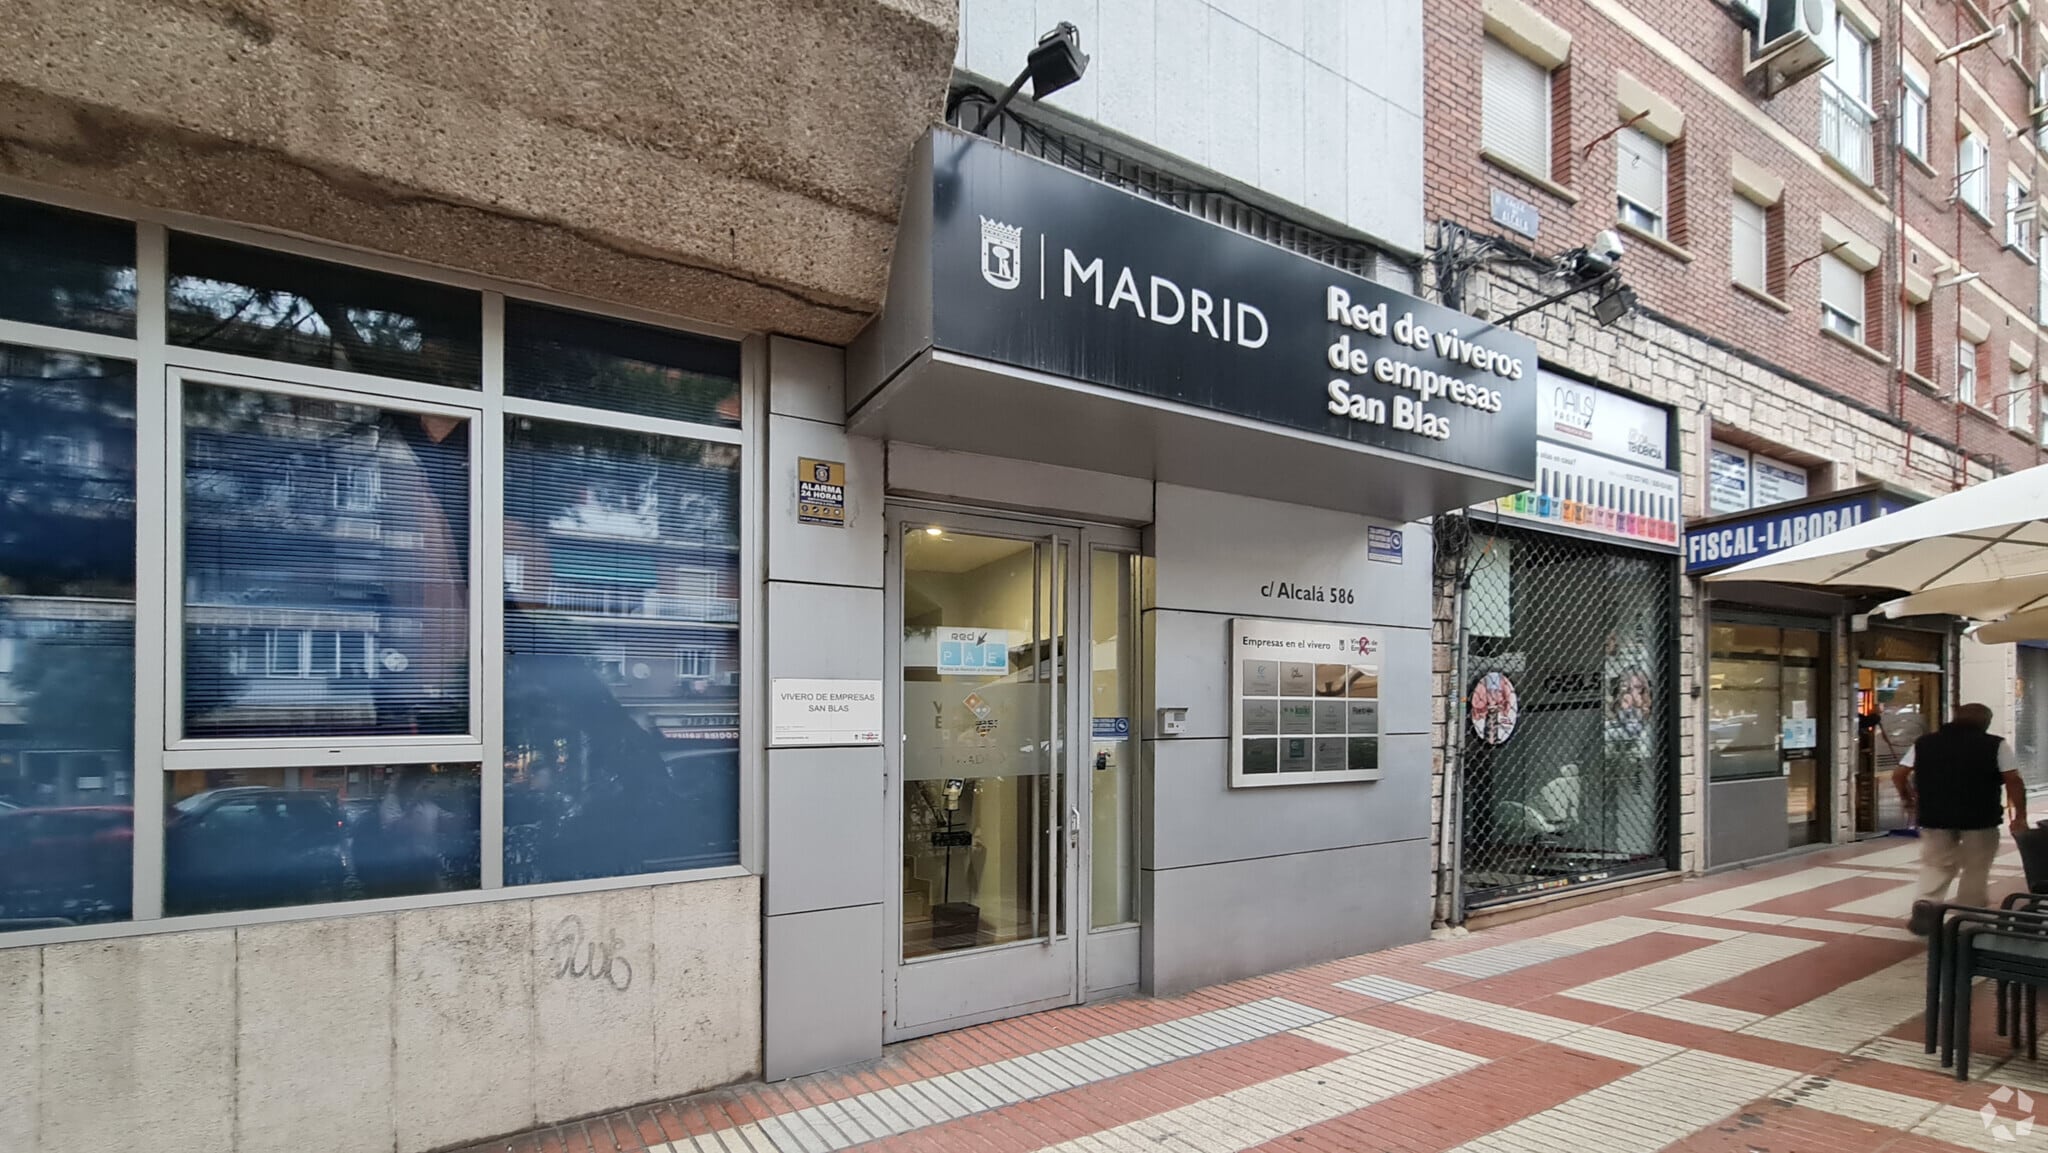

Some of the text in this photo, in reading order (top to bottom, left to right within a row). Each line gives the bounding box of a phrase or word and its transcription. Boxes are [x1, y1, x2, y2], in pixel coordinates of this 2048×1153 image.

[1064, 248, 1269, 349] MADRID
[1327, 285, 1523, 380] Red de viveros
[1327, 334, 1502, 413] de empresas
[1327, 378, 1451, 440] San Blas
[1554, 386, 1594, 418] NAILS
[801, 482, 842, 494] ALARMA
[813, 491, 842, 501] HORAS
[1261, 581, 1355, 605] c/ Alcalá 586
[1242, 636, 1331, 650] Empresas en el vivero
[780, 693, 875, 702] VIVERO DE EMPRESAS
[808, 704, 826, 712] SAN
